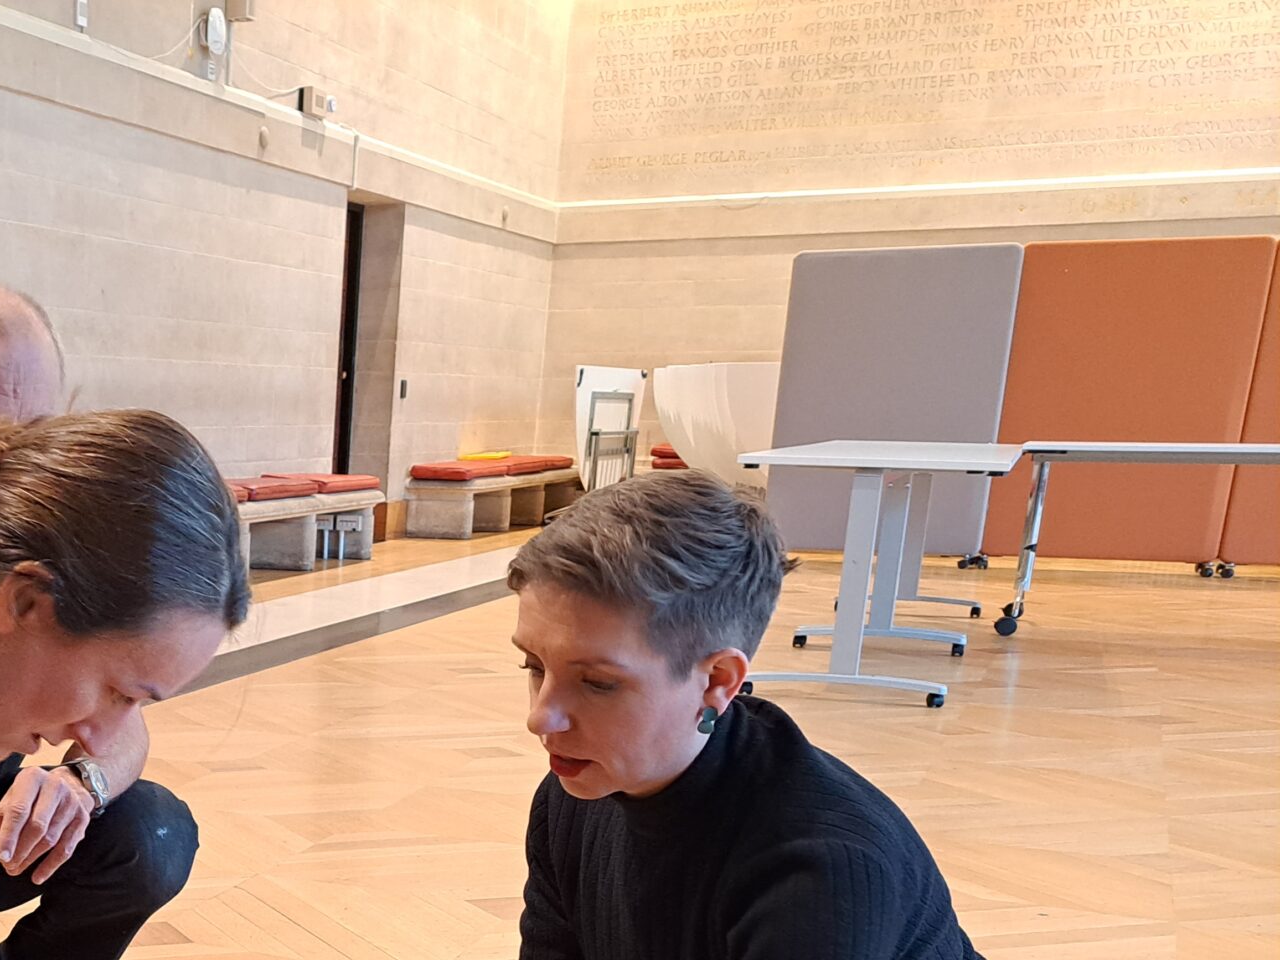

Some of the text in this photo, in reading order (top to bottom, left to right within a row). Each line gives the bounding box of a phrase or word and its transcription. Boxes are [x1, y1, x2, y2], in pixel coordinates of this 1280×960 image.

[804, 19, 859, 36] GEORGE
[864, 14, 921, 32] BRYANT
[924, 8, 984, 25] BRITTON
[672, 45, 728, 62] FRANCIS
[733, 39, 799, 57] CLOTHIER
[649, 60, 724, 78] WHITFIELD
[728, 56, 773, 73] STONE
[860, 59, 934, 79] RICHARD
[939, 54, 974, 73] GILL
[592, 96, 642, 113] GEORGE
[694, 88, 752, 106] WATSON
[757, 84, 804, 101] ALLAN
